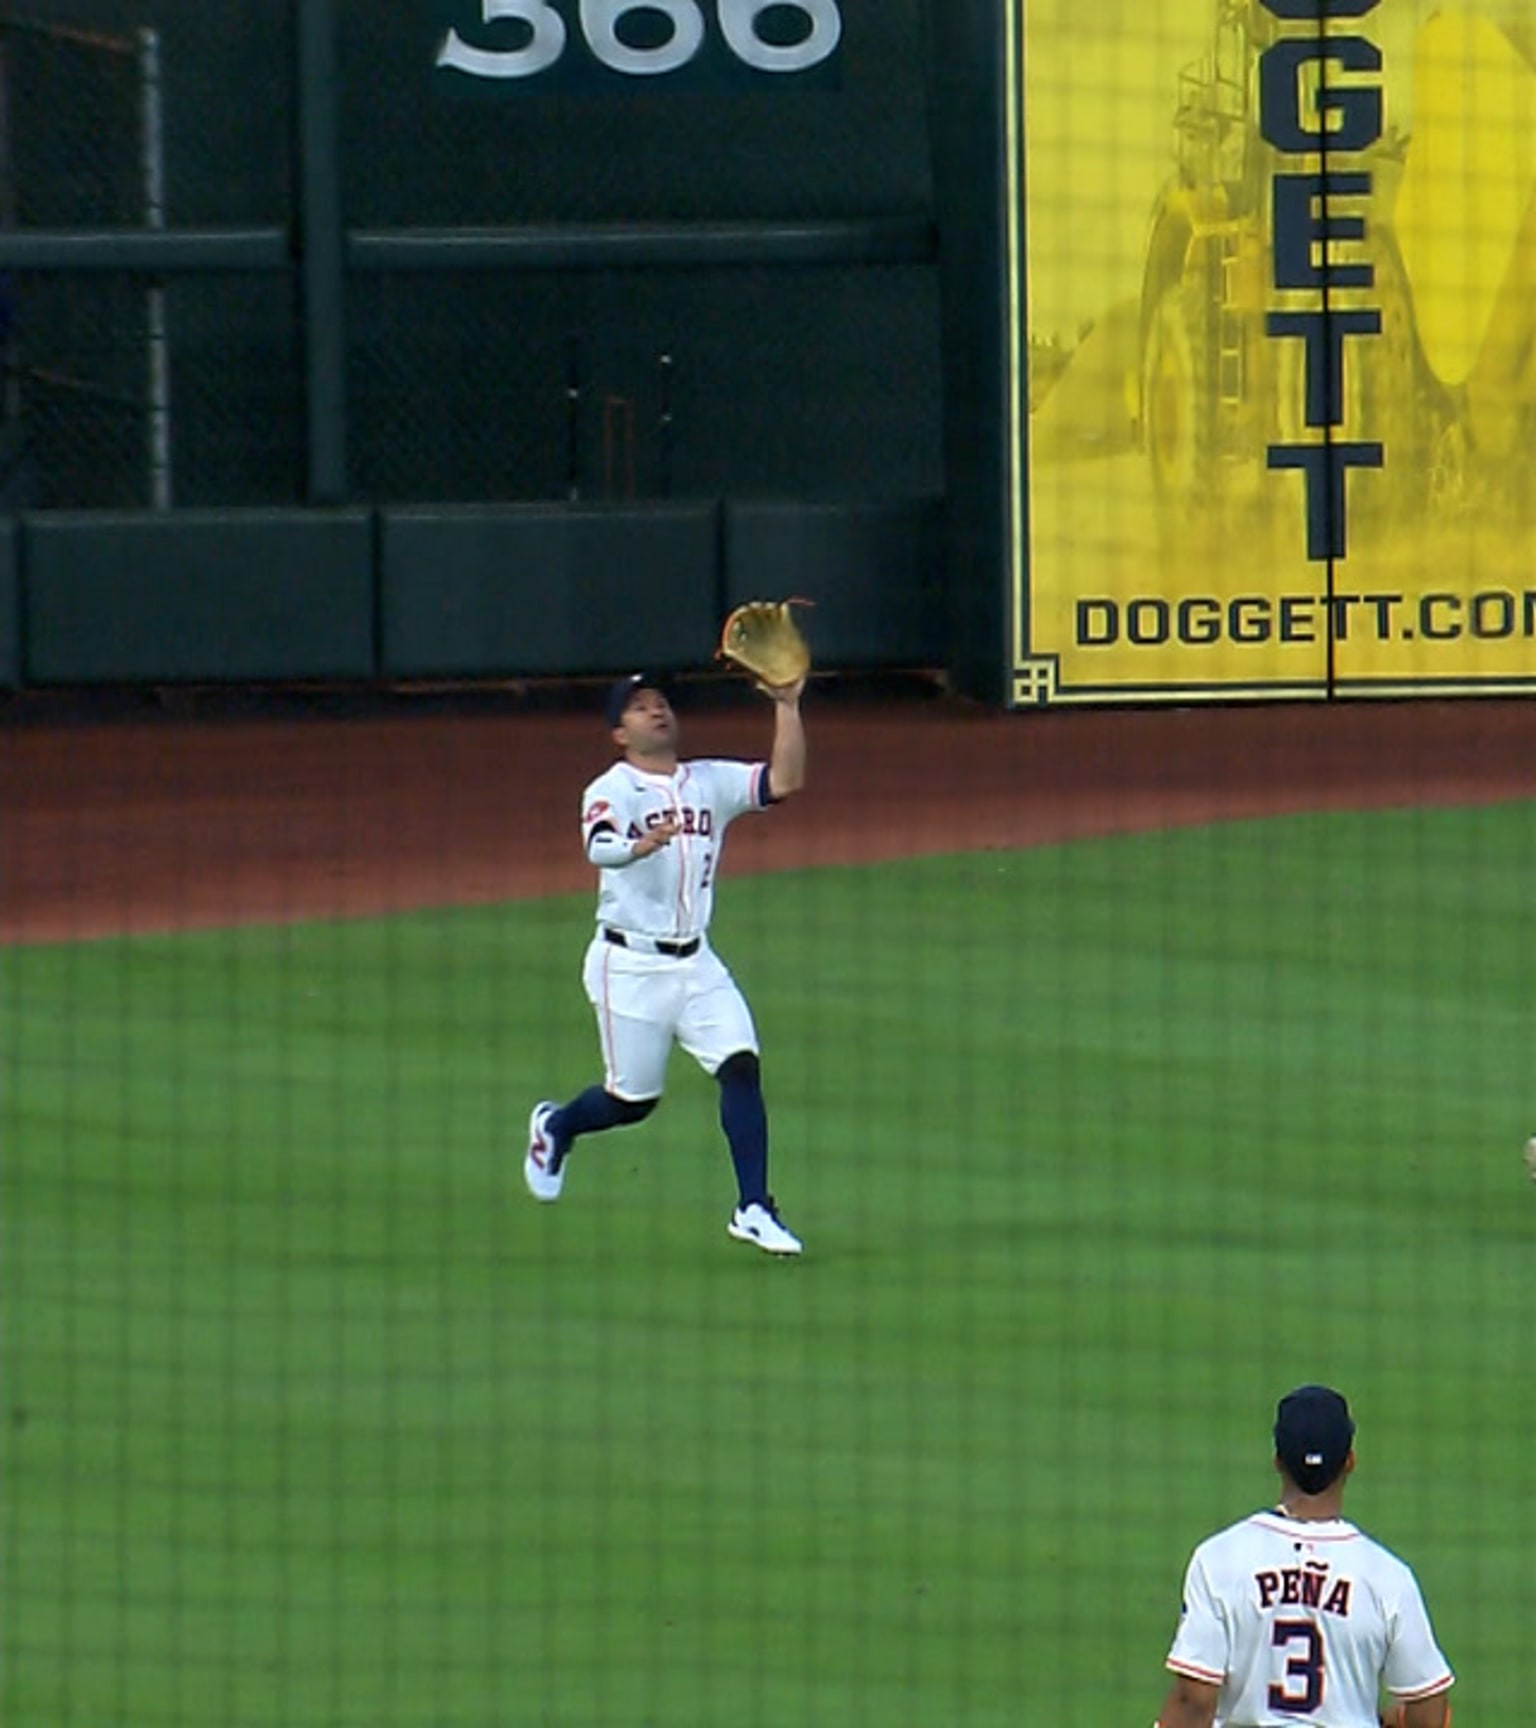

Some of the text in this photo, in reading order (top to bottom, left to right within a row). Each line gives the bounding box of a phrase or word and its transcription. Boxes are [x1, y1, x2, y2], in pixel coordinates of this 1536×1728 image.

[1257, 0, 1384, 561] GETT
[1254, 1560, 1352, 1618] PEÑA
[1266, 1618, 1326, 1715] 3
